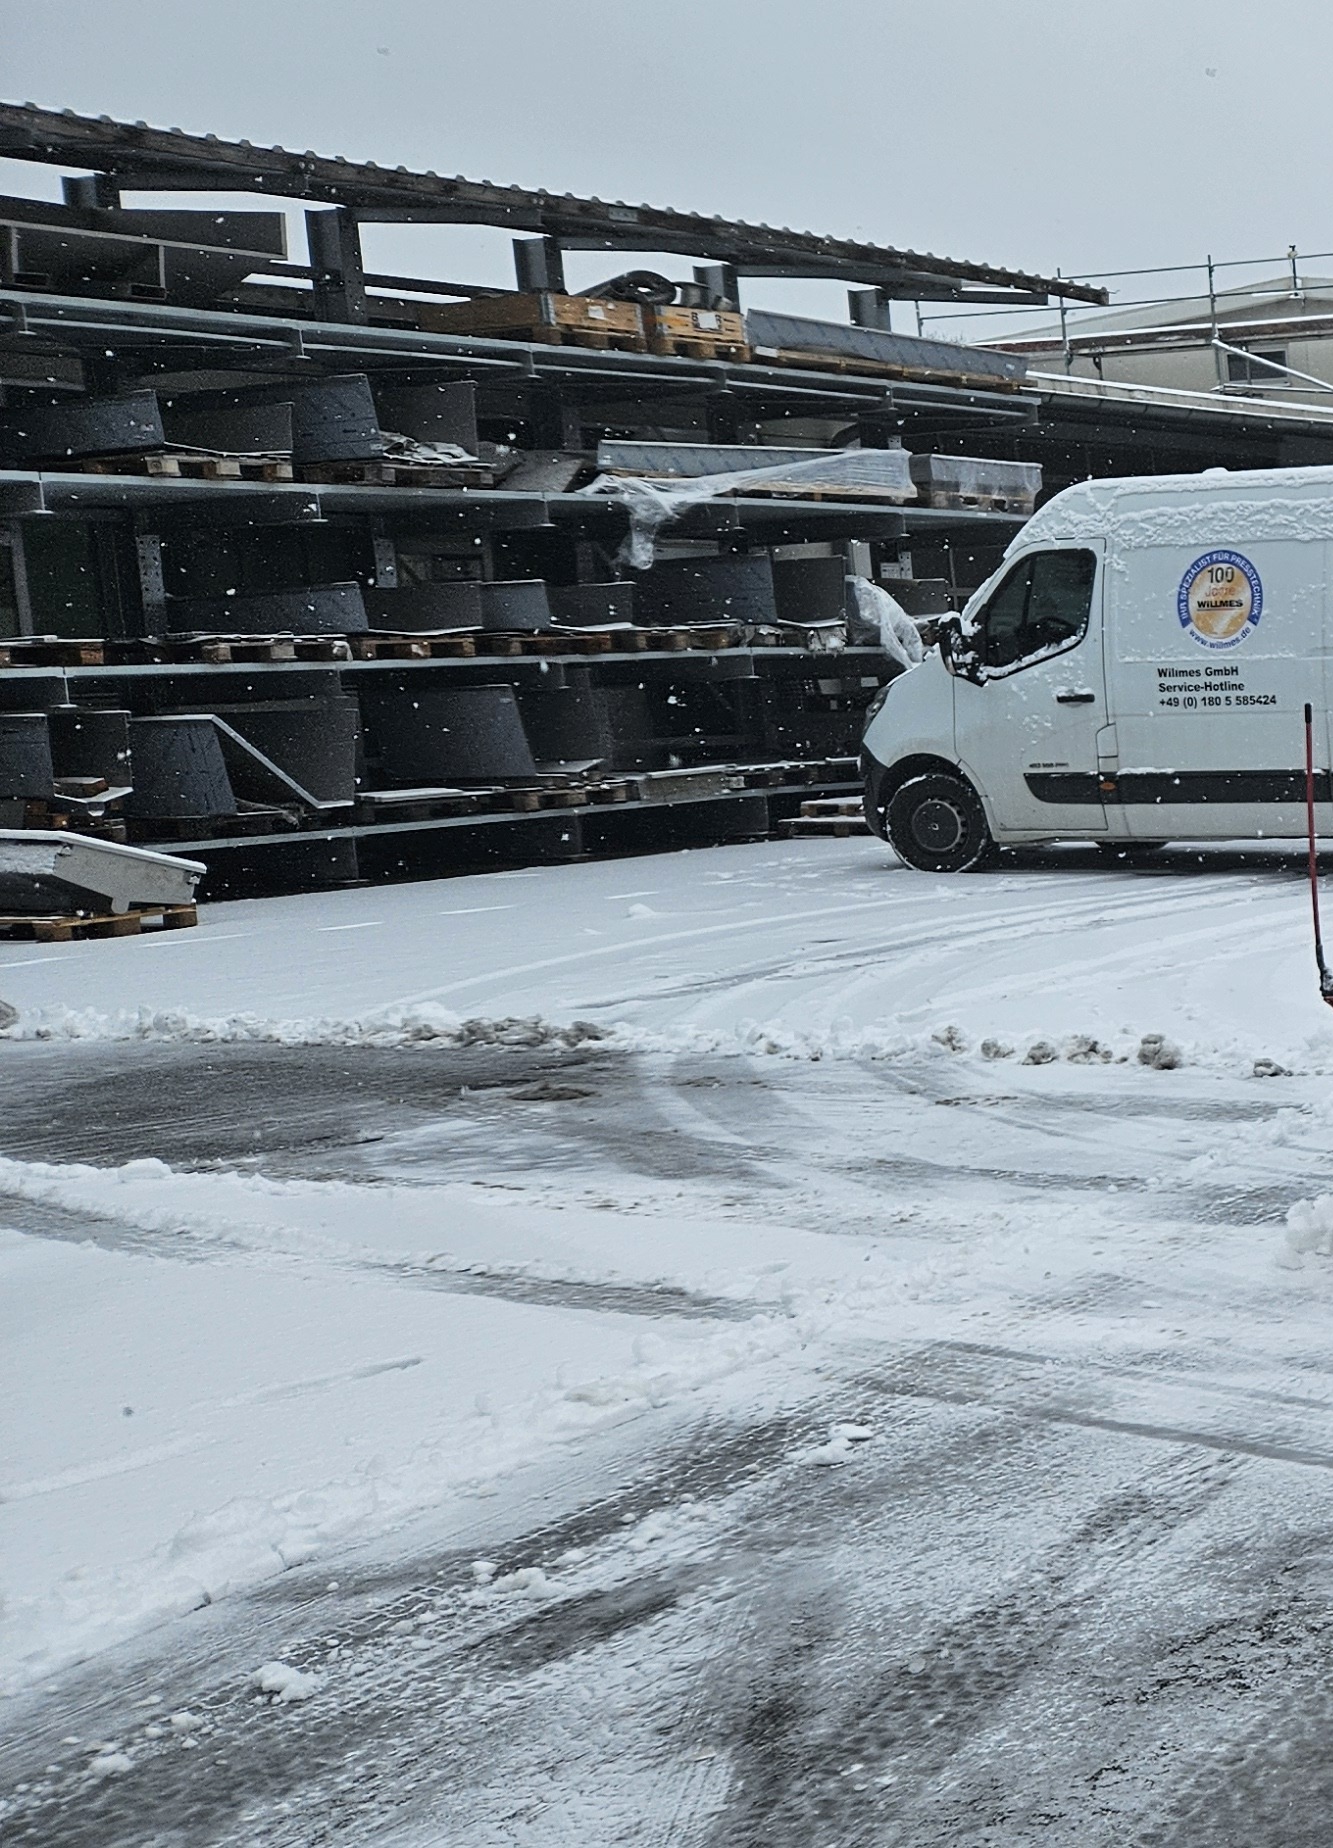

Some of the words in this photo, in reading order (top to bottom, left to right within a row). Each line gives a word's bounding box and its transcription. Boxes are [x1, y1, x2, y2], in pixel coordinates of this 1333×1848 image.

[1181, 556, 1212, 601] SPEZIALIST
[1207, 566, 1236, 584] 100
[1196, 599, 1244, 609] WILLMES
[1189, 626, 1253, 650] www.willmes.de
[1204, 665, 1240, 677] GmbH
[1158, 681, 1246, 693] Service-Hotline
[1159, 696, 1180, 707] +49
[1182, 696, 1199, 709] (0)
[1200, 696, 1222, 707] 180
[1224, 695, 1233, 706] 5
[1235, 694, 1278, 706] 585424
